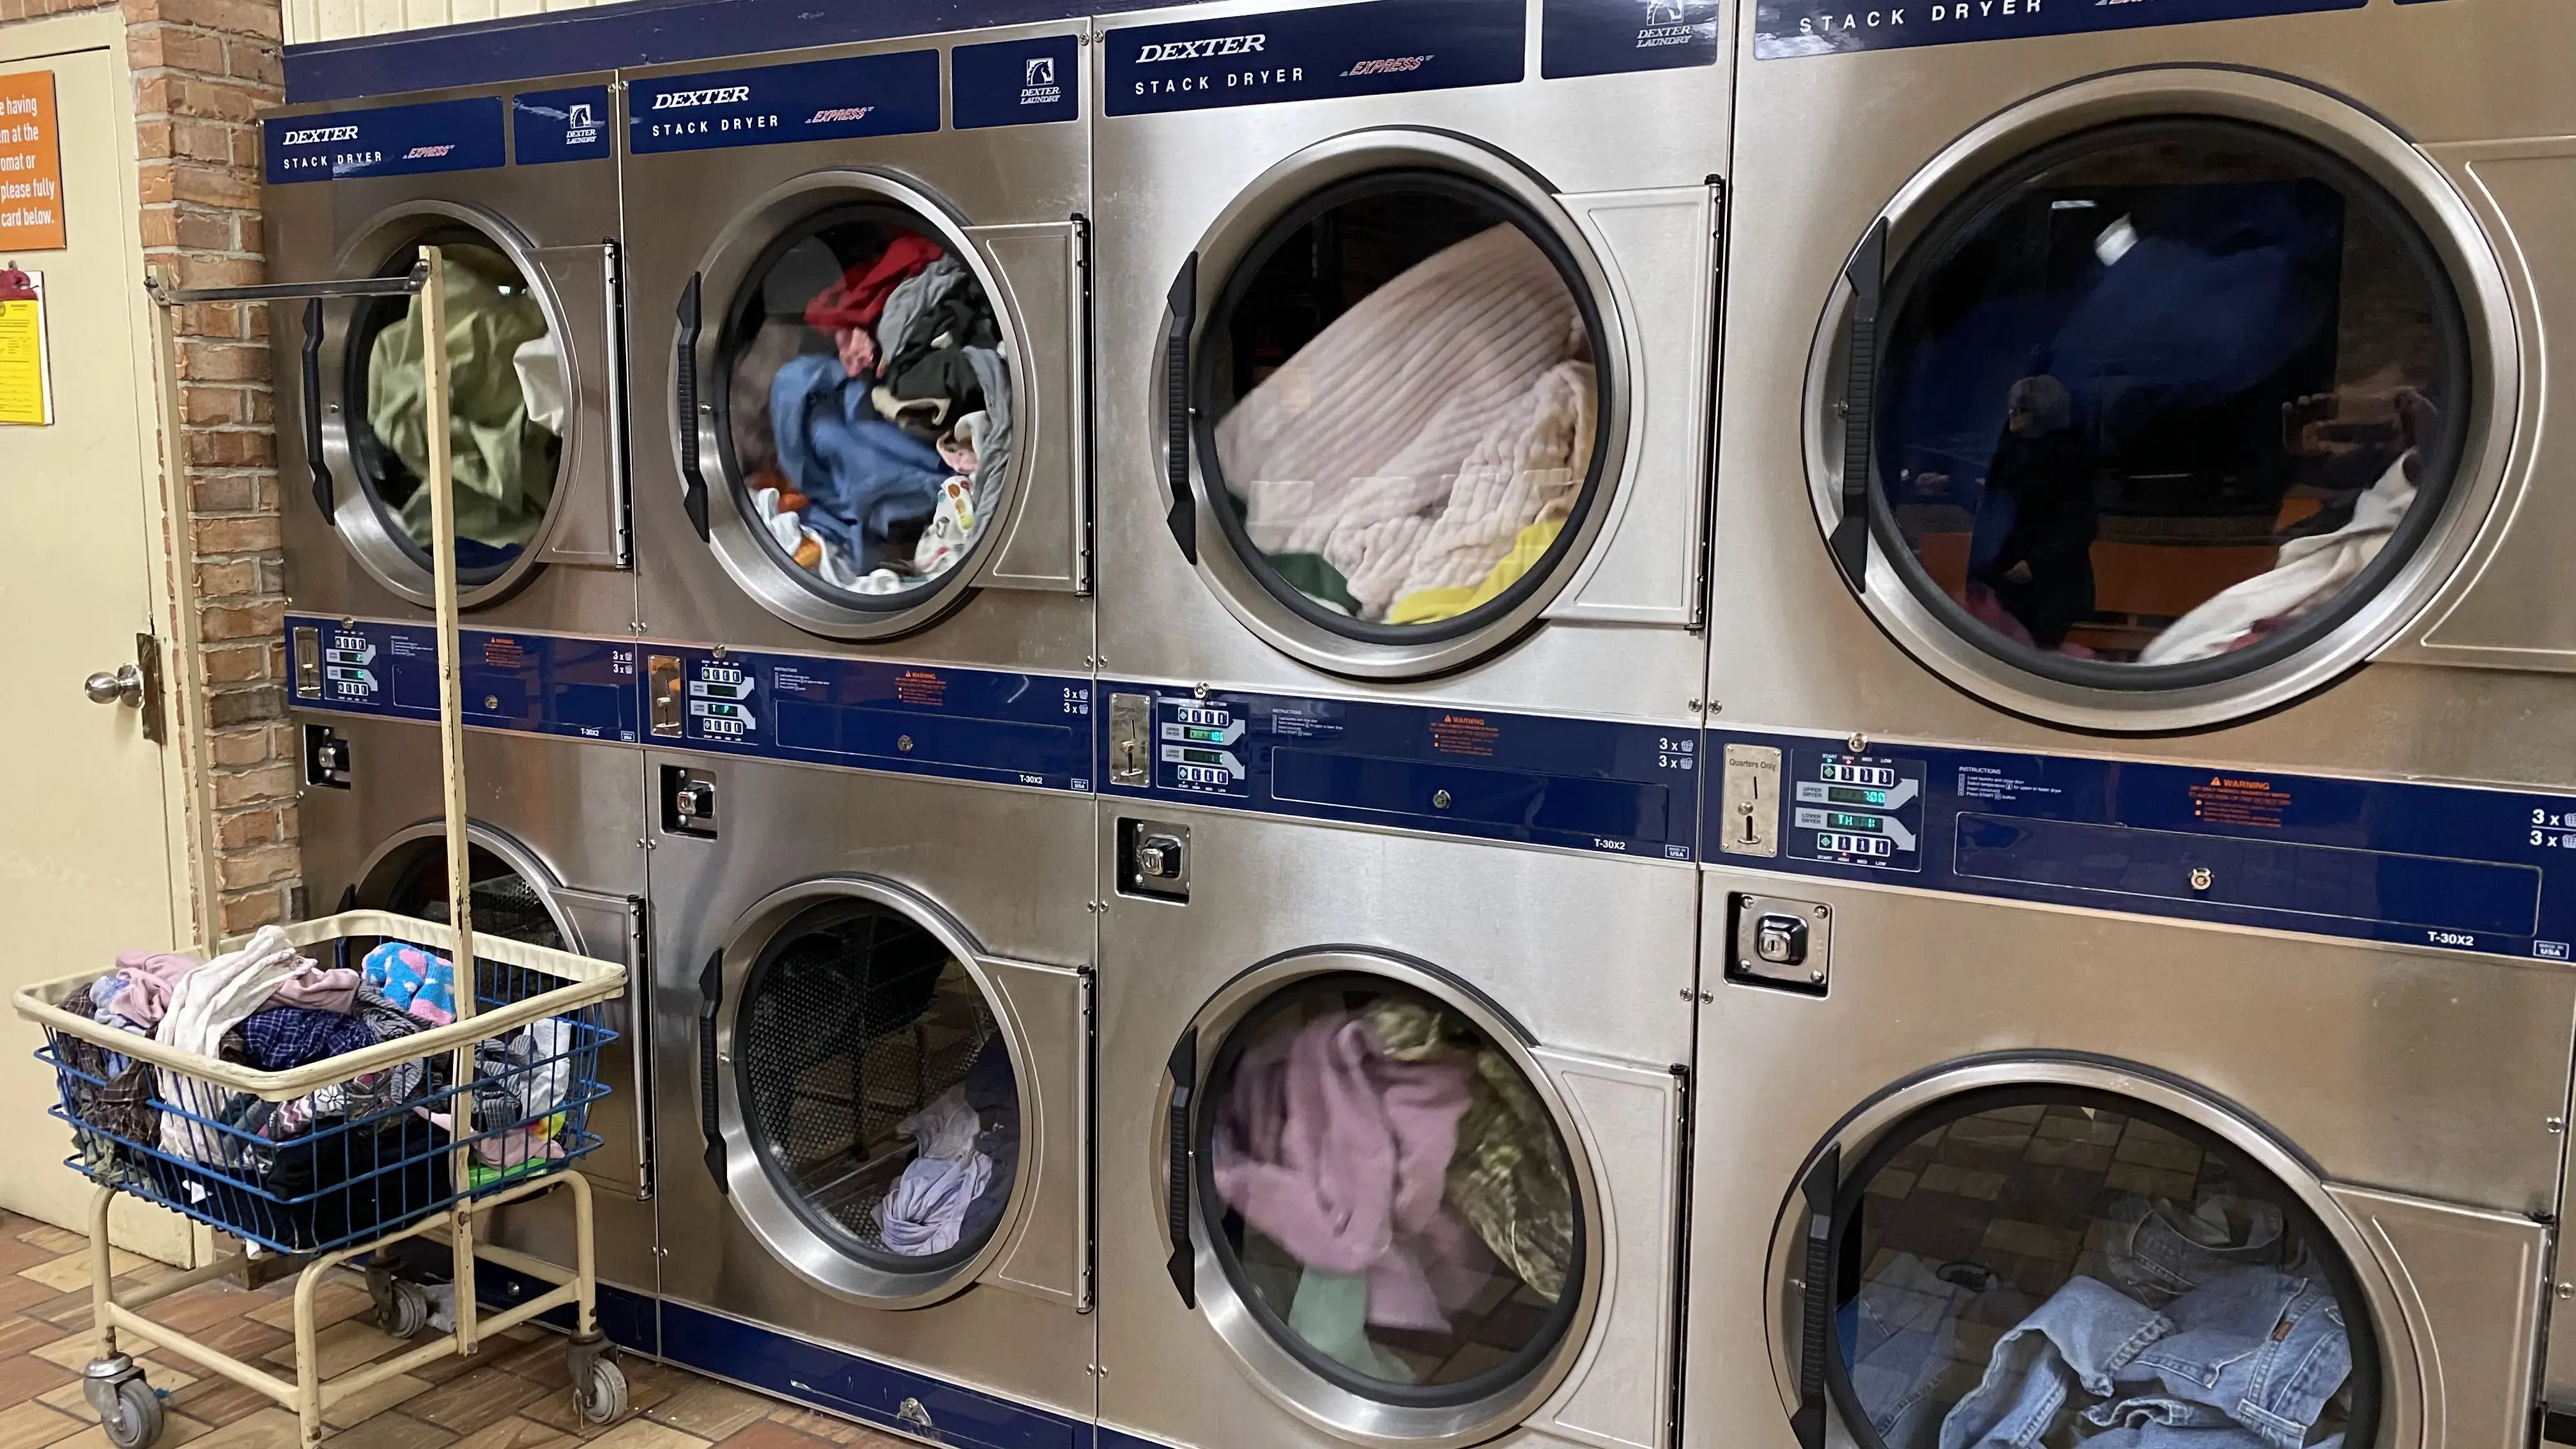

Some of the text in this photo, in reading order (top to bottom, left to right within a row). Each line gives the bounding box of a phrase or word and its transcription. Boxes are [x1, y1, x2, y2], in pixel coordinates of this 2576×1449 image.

[1799, 0, 2041, 33] STACK DRYER
[1637, 26, 1691, 39] DEXTER
[1636, 35, 1692, 48] LAUNDRY
[1135, 34, 1266, 64] DEXTER
[1349, 56, 1425, 75] EXPRESS
[1135, 68, 1303, 95] STACK DRYER
[652, 86, 749, 109] DEXTER
[1020, 87, 1061, 96] DEXTER
[6, 95, 37, 117] having
[1020, 95, 1061, 105] LAUNDRY
[811, 107, 868, 123] EXPRESS
[12, 125, 22, 142] at
[23, 123, 38, 141] the
[652, 115, 778, 137] STACK DRYER
[283, 126, 358, 146] DEXTER
[566, 129, 595, 138] DEXTER
[566, 136, 597, 144] LAUNDRY
[407, 145, 450, 158] EXPRESS
[26, 155, 36, 169] or
[284, 151, 382, 170] STACK DRYER
[1, 177, 54, 203] please fully
[1, 207, 54, 227] card below.
[613, 650, 618, 660] 3
[613, 664, 618, 673] 3
[1064, 687, 1070, 698] 3
[1064, 703, 1070, 713] 3
[1453, 717, 1484, 725] WARNING
[1659, 738, 1678, 751] 3 x
[1659, 755, 1677, 769] 3 x
[1729, 758, 1776, 772] Quarters Only
[1020, 775, 1043, 784] T-30X2
[2224, 779, 2269, 790] WARNING
[2532, 809, 2559, 825] 3 x
[1594, 838, 1625, 850] T-30X2
[2530, 831, 2557, 847] 3 x
[2428, 931, 2474, 946] T-30X2
